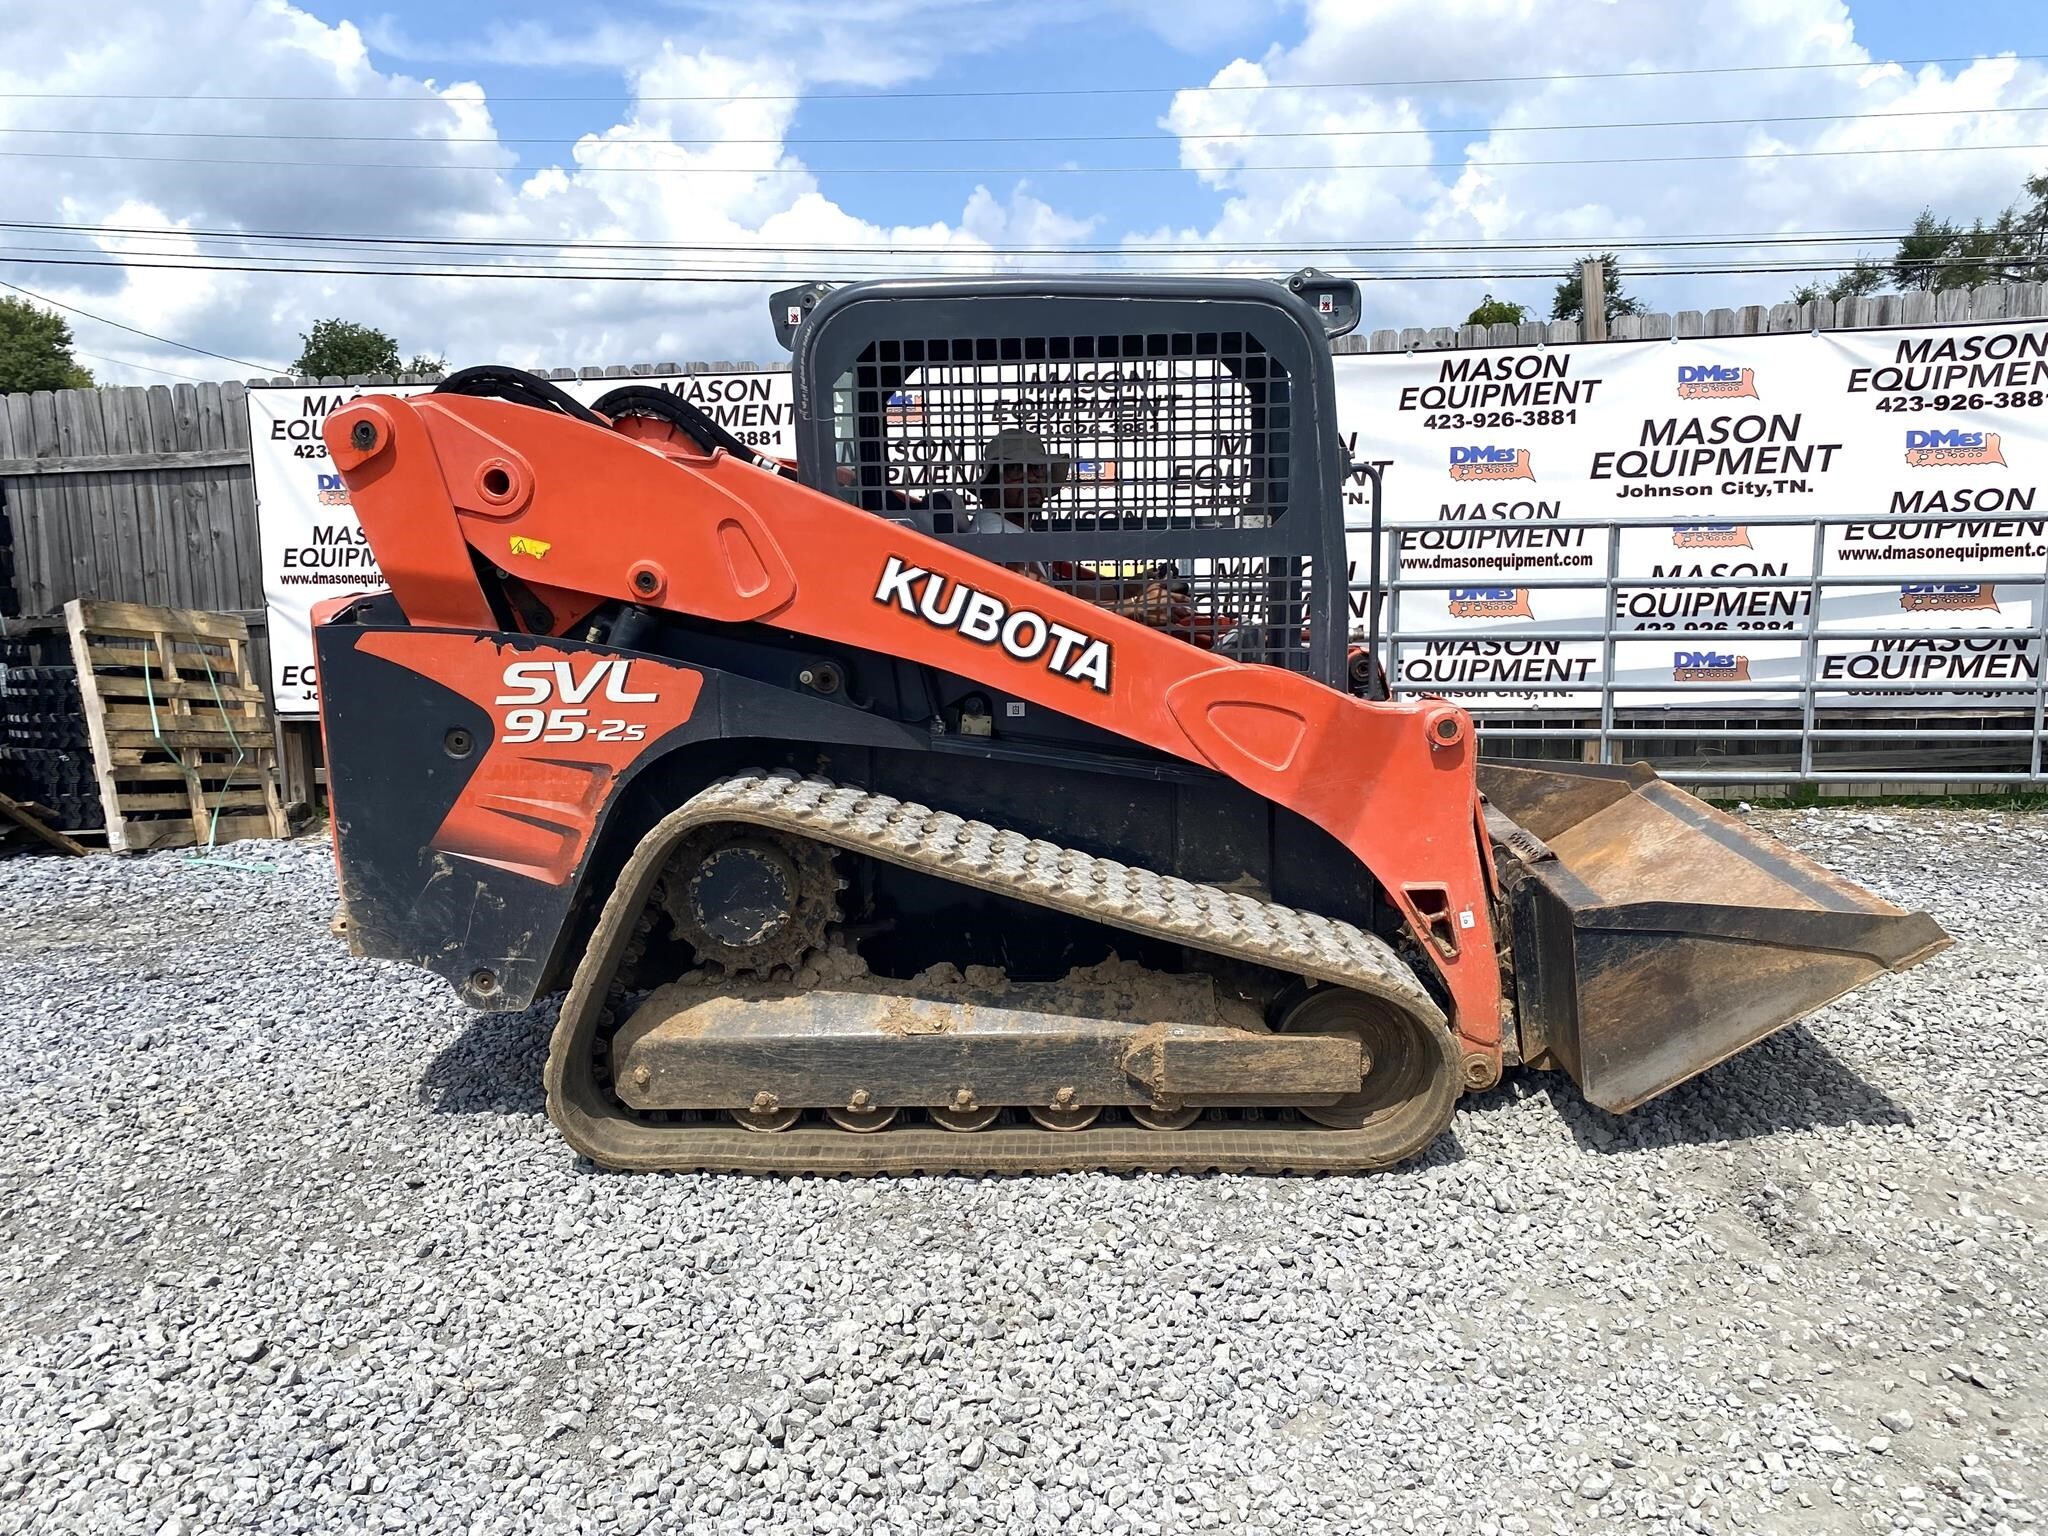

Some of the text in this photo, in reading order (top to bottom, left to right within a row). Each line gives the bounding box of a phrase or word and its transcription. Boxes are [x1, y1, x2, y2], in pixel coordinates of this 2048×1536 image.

[1439, 354, 1570, 382] MASON
[1847, 360, 2048, 393] EQUIPMEN
[1398, 380, 1602, 411] EQUIPMENT
[1875, 390, 2048, 413] 423-926-388
[1423, 409, 1577, 430] 423-926-3881
[1640, 413, 1802, 447] MASON
[1590, 444, 1843, 480] EQUIPMENT
[1616, 482, 1713, 498] Johnson
[1890, 487, 2037, 514] MASON
[1438, 501, 1561, 521] MASON
[313, 526, 367, 546] MAS
[1399, 553, 1593, 571] www.dmasonequipment.com
[1838, 542, 2047, 562] www.dmasonequipment.c
[873, 555, 1112, 692] KUBOTA
[494, 660, 660, 706] SVL
